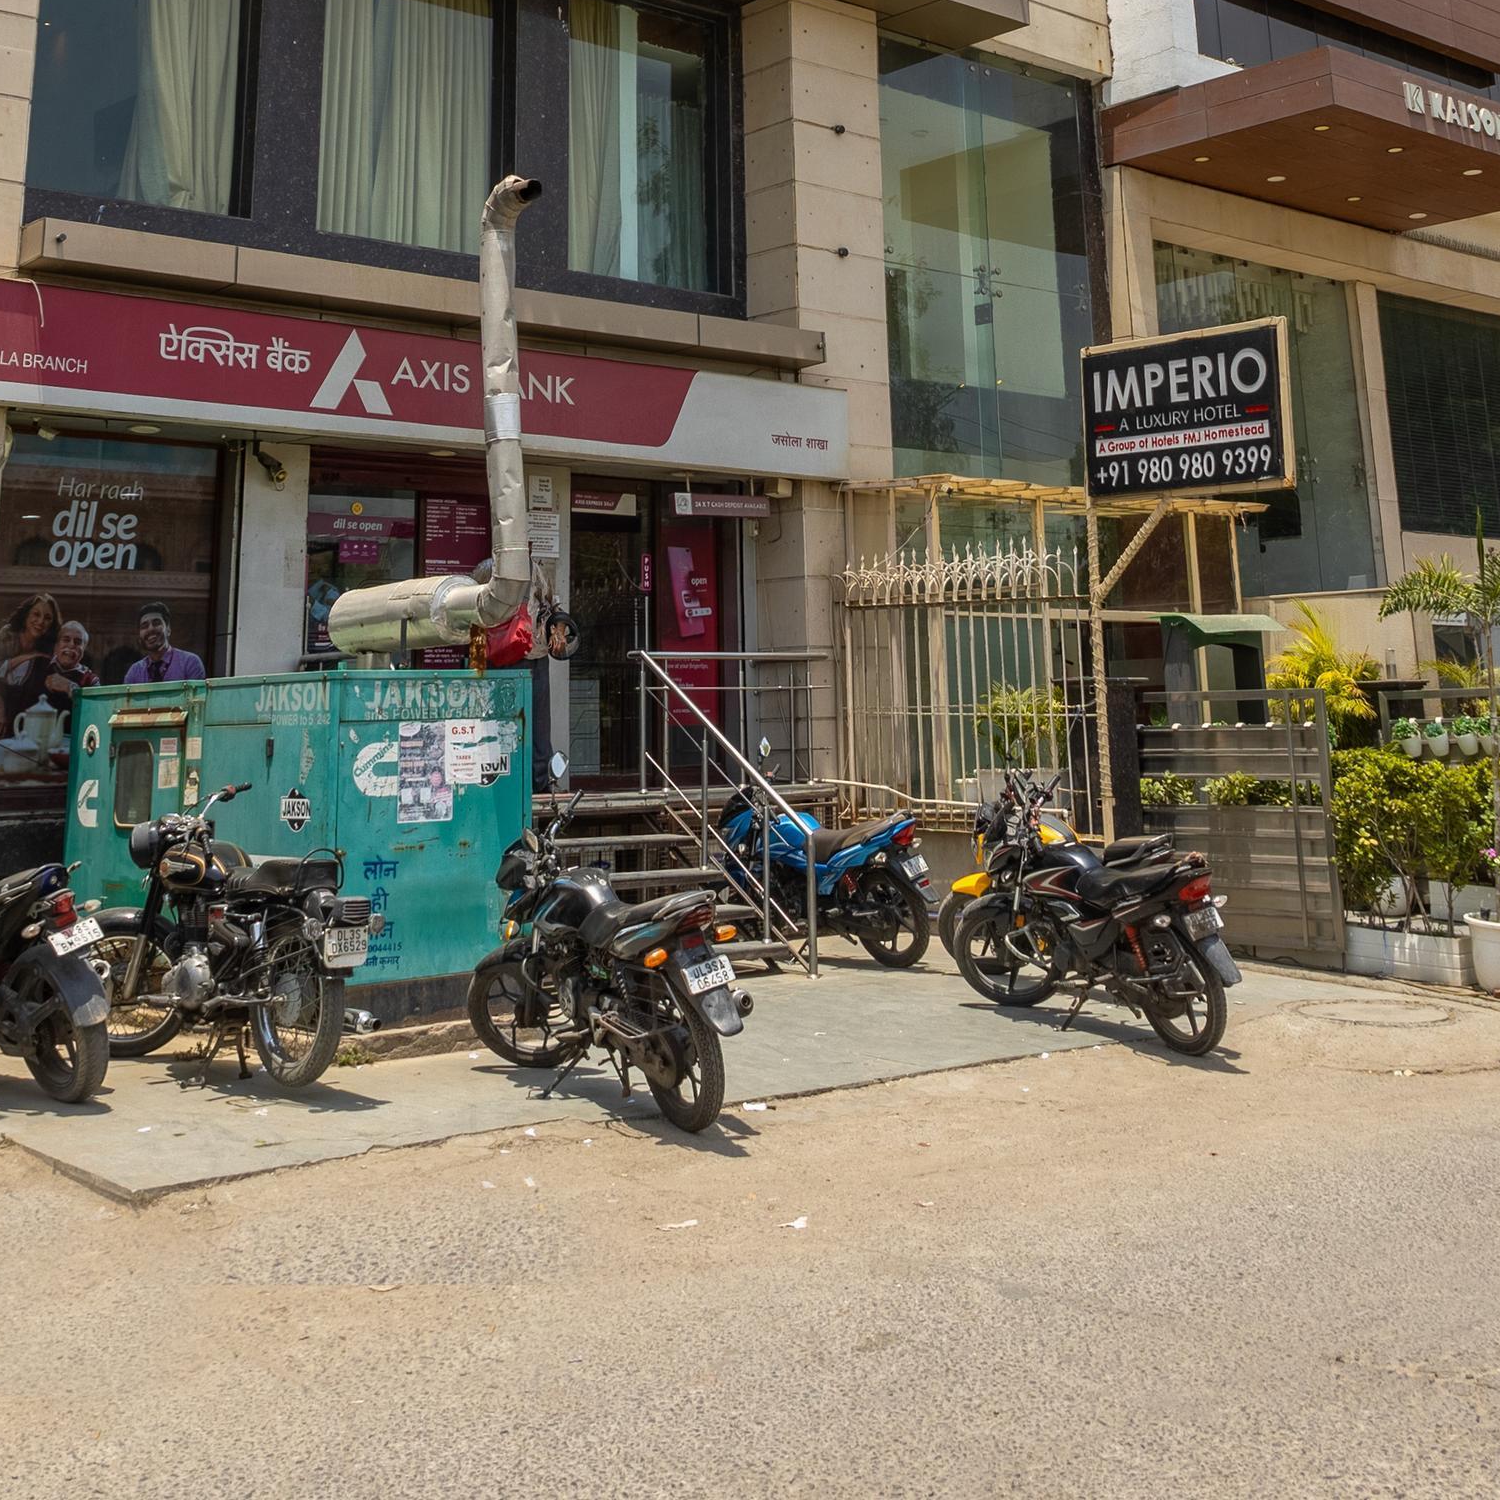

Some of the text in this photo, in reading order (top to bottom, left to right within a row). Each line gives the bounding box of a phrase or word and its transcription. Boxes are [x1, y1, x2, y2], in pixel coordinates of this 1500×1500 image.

[23, 353, 88, 374] BRANCH
[266, 336, 311, 374] बैंक
[391, 356, 575, 405] AXIS NK
[1093, 348, 1267, 413] IMPERIO
[1119, 404, 1241, 431] A LUXURY HOTEL
[1099, 442, 1106, 453] A
[1107, 437, 1136, 451] Group
[1139, 436, 1148, 448] of
[1151, 433, 1179, 446] Hotels
[1204, 424, 1265, 441] Homestead
[1096, 444, 1272, 487] +91 980 980 9399
[58, 476, 96, 498] Har
[52, 500, 138, 540] dil se
[333, 518, 383, 532] dil se open
[49, 540, 138, 575] open
[691, 577, 707, 586] open
[255, 682, 331, 712] JAKSON
[365, 679, 488, 709] JAKSON
[271, 714, 298, 726] POWER
[393, 708, 438, 721] POWER
[451, 725, 476, 735] G.S.T
[354, 743, 394, 777] Cummins
[281, 800, 310, 817] JAKSON
[363, 854, 399, 880] लोन
[332, 940, 367, 954] DX6529
[337, 928, 361, 941] DL3S
